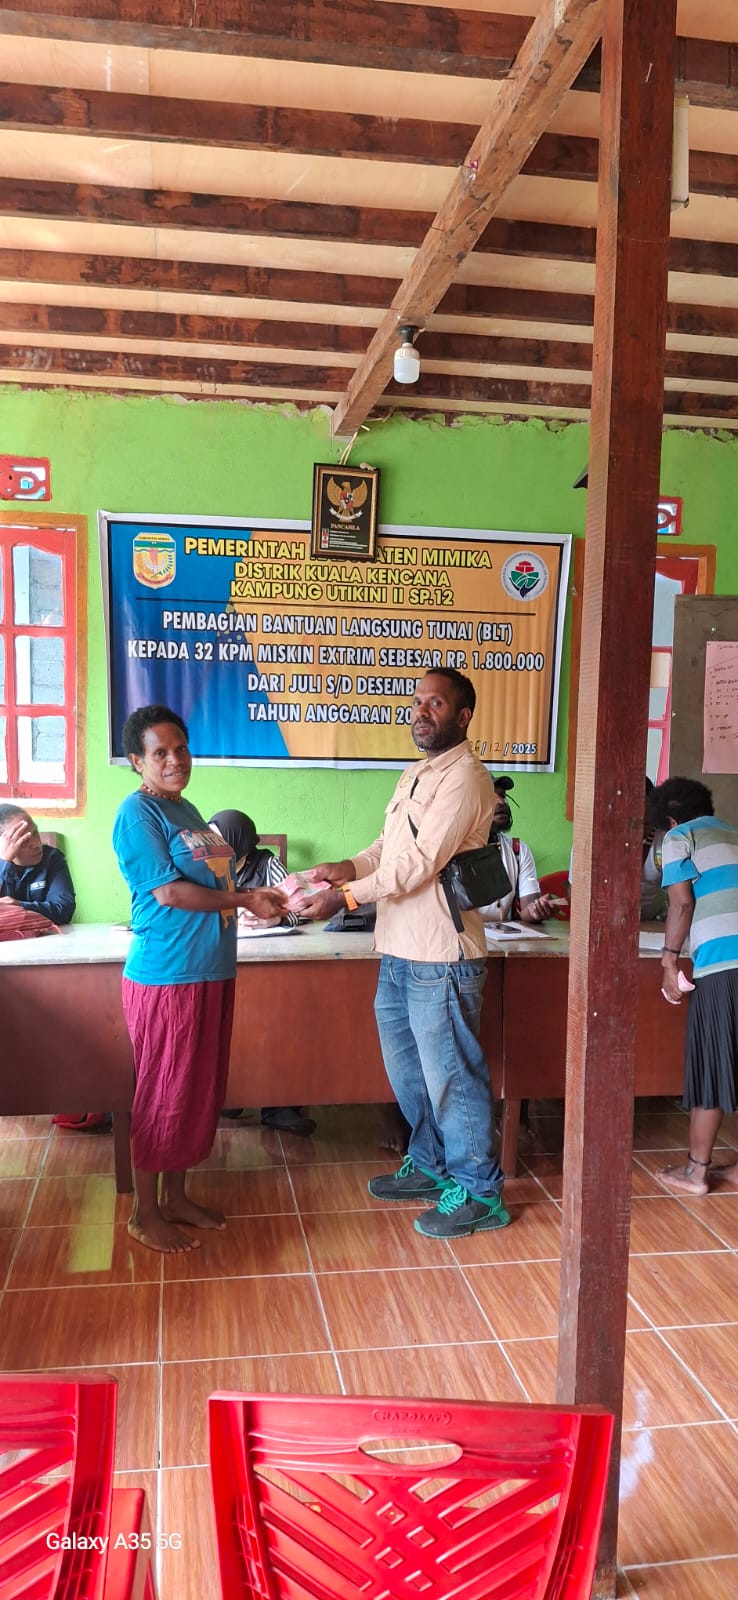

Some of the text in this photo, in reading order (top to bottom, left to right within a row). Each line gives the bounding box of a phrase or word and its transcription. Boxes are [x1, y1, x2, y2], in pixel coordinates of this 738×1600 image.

[185, 537, 305, 560] PEMERINTAH
[422, 548, 492, 569] MIMIKA
[235, 561, 449, 588] DISTRIK KUALA KENCANA
[230, 579, 454, 606] KAMPUNG UTIKINI II SP.12
[163, 611, 513, 645] PEMBAGIAN BANTUAN LANGSUNG TUNAI (BLT)
[128, 640, 544, 672] KEPADA 32 KPM MISKIN EXTRIM SEBESAR RP. 1.800.000
[248, 674, 422, 698] DARI JULI S/D DESEMB
[248, 703, 412, 724] TAHUN ANGGARAN 20
[511, 743, 538, 755] 2025
